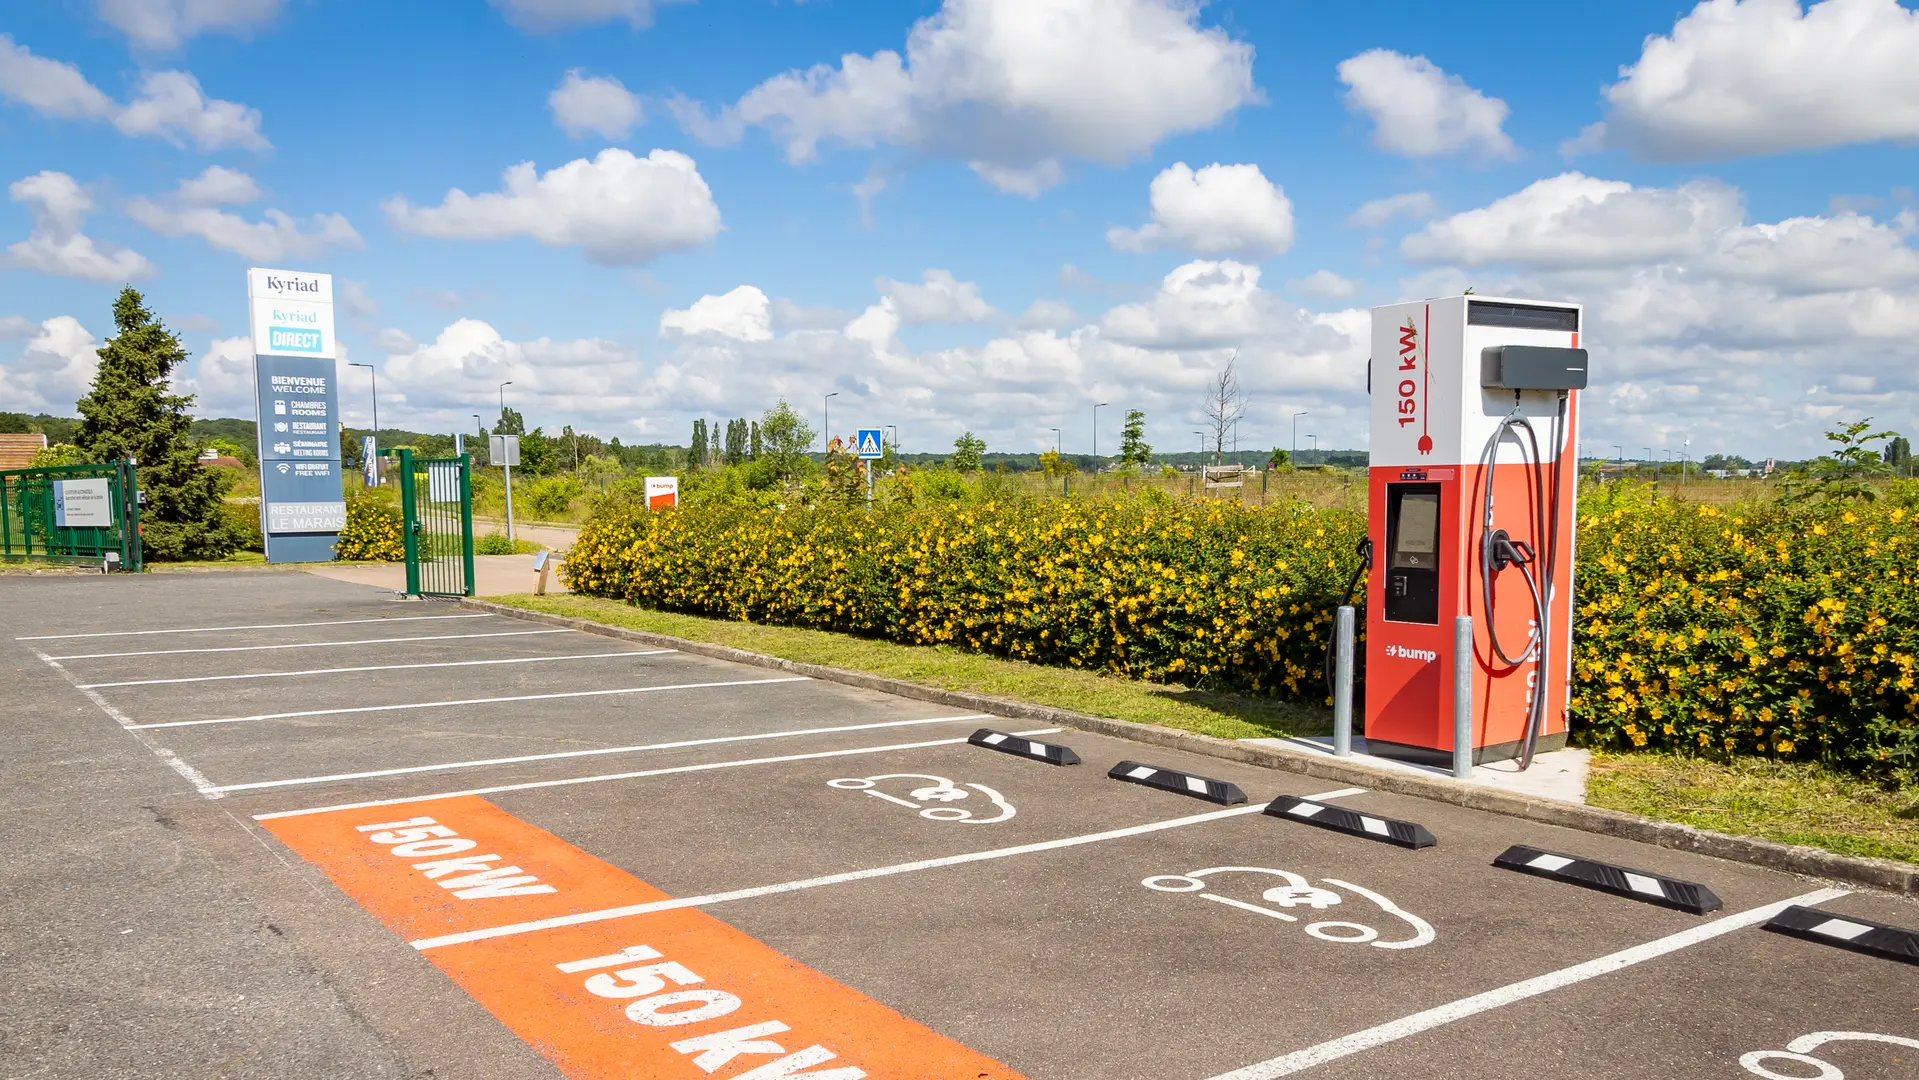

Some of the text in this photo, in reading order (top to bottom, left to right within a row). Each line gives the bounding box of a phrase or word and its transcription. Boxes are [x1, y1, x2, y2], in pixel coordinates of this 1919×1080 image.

[267, 275, 319, 294] Kyriad
[272, 308, 317, 325] Kyriad
[272, 331, 320, 349] DIRECT
[271, 375, 326, 387] BIENVENUE
[1398, 326, 1416, 428] 150 kW
[271, 385, 327, 394] WELCOME
[291, 400, 327, 410] CHAMBRES
[291, 409, 327, 417] ROOMS
[292, 421, 327, 430] RESTAURANT
[271, 504, 344, 516] RESTAURANT
[272, 516, 345, 530] LE MARAIS
[1398, 645, 1437, 663] bump
[355, 816, 478, 858] 150
[555, 945, 742, 1027] 150
